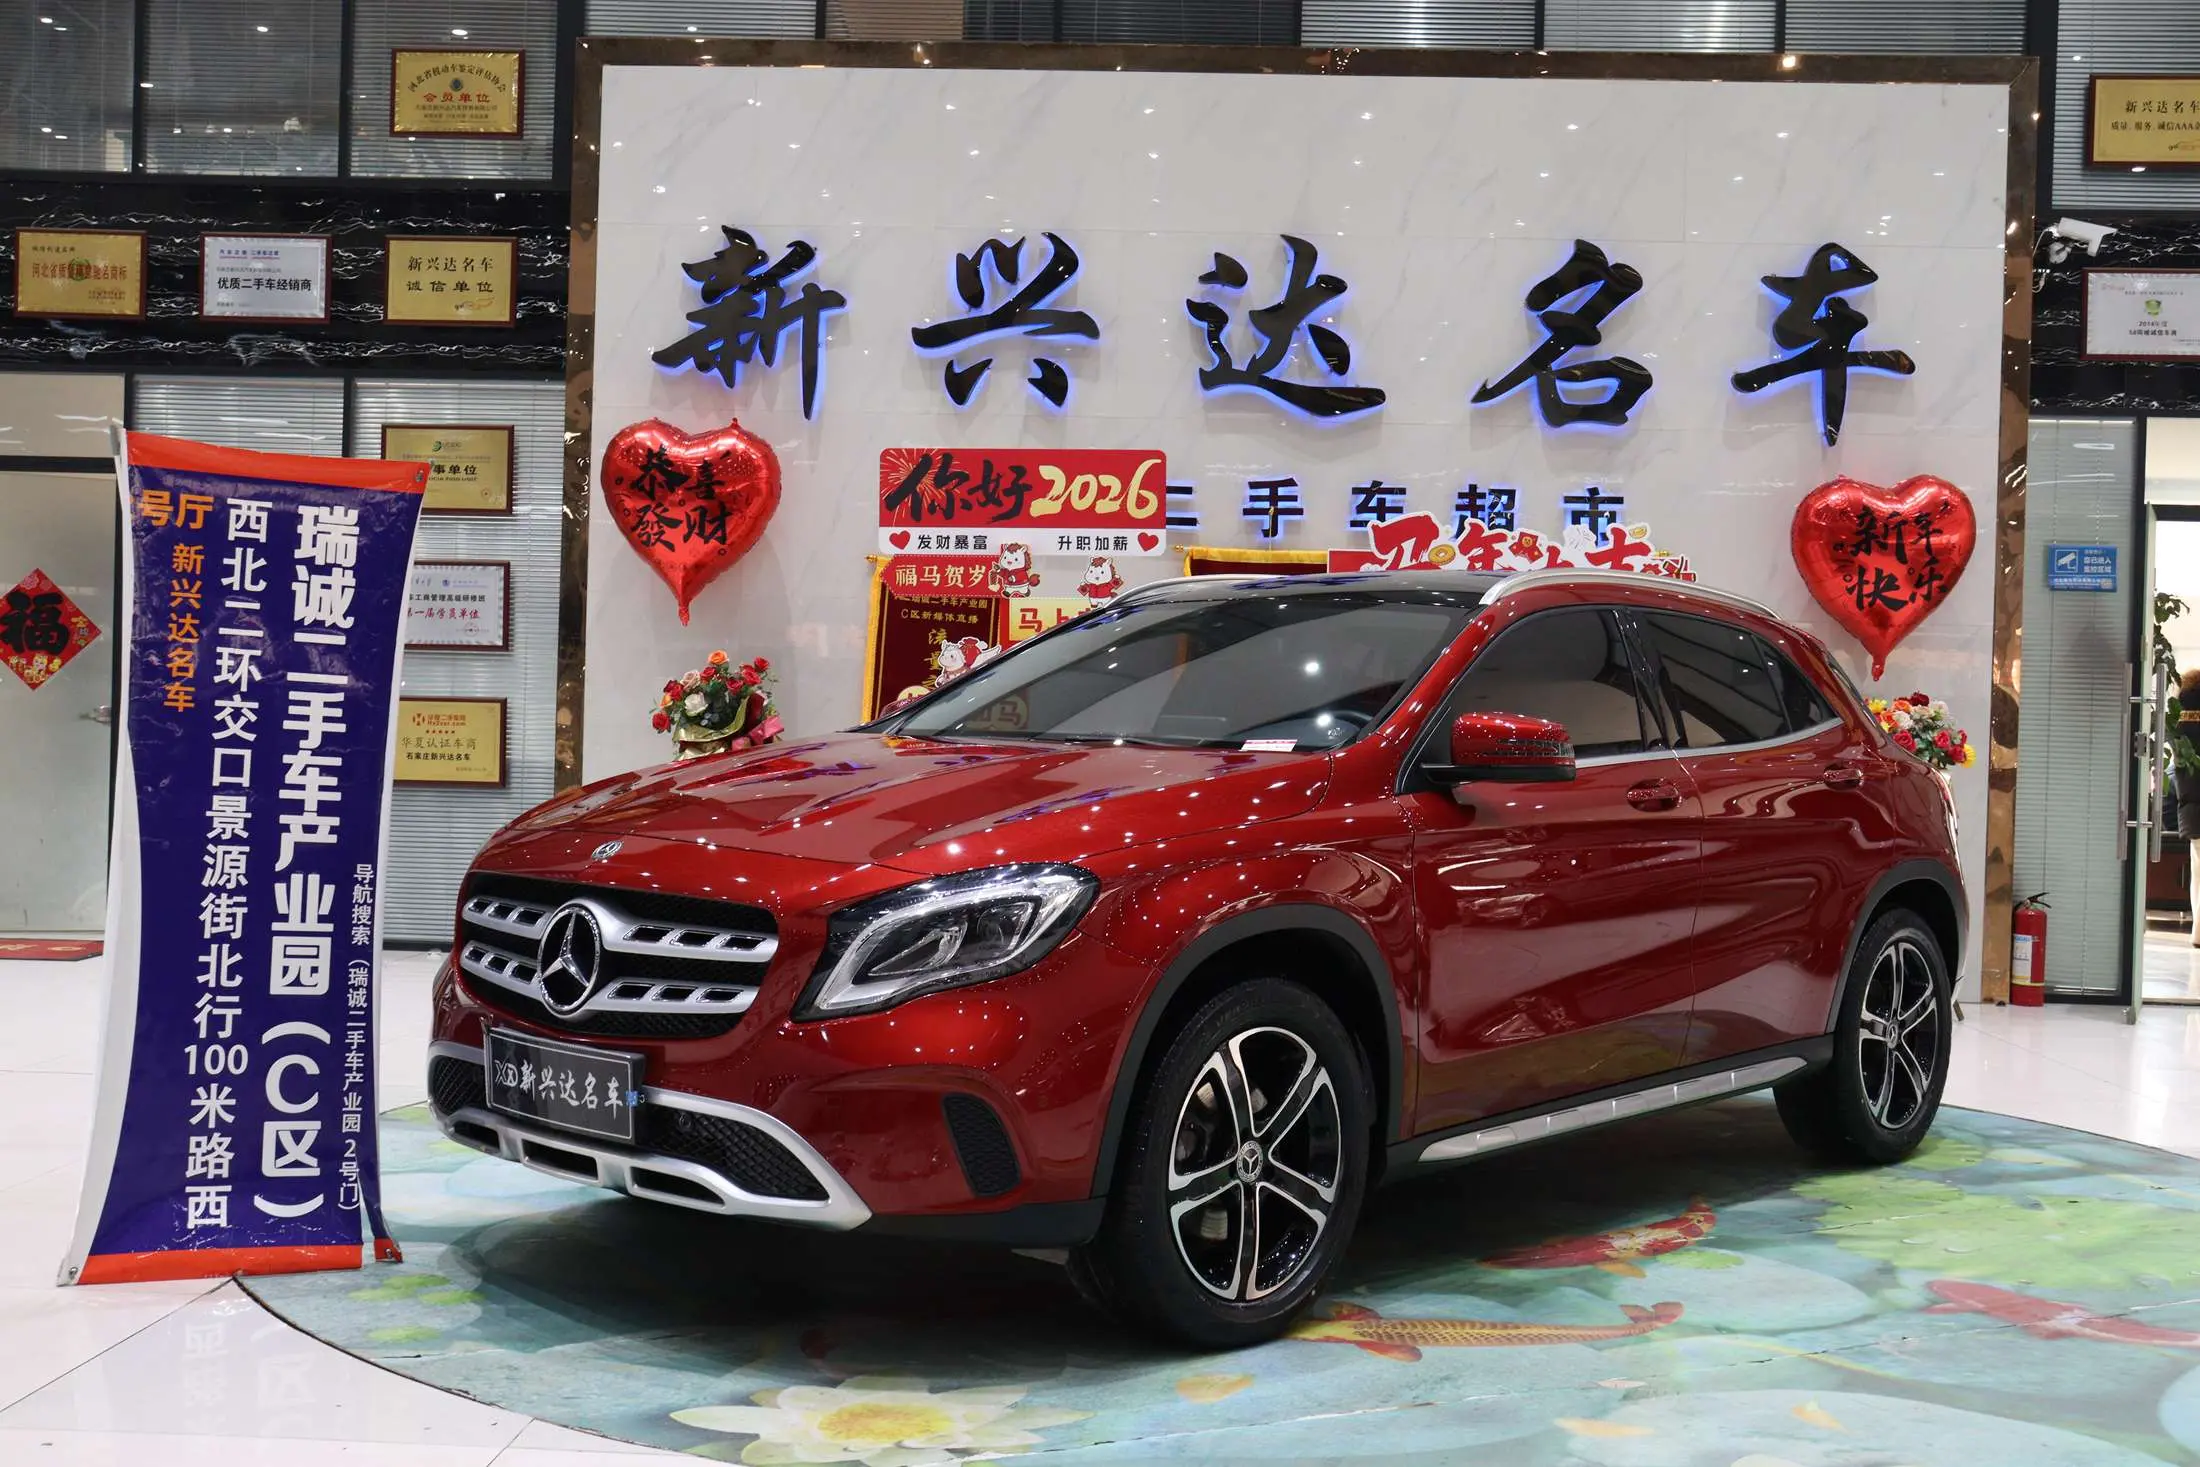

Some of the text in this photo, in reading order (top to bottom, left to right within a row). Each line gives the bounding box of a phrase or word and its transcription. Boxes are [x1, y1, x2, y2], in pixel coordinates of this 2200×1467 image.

[423, 92, 490, 103] 会员单位
[2126, 100, 2200, 114] 新兴达名车
[407, 256, 494, 273] 新兴达名车
[217, 277, 313, 292] 优质二手车经销商
[406, 280, 494, 293] 诚信单位
[652, 225, 1916, 447] 新兴达名车
[431, 463, 478, 476] 事单位
[1851, 502, 1945, 565] 新年
[917, 534, 988, 551] 发财暴富
[1057, 535, 1129, 552] 升职加薪
[895, 564, 986, 588] 福马贺岁
[1845, 555, 1949, 612] 快乐
[0, 592, 69, 655] 福
[901, 608, 979, 624] C区新媒体直播
[163, 543, 205, 712] 新兴达名车
[400, 736, 478, 750] 华夏认证车商
[405, 752, 472, 761] 石家庄新兴达名车
[184, 497, 273, 1229] 西北二环交口景源街北行100米路西
[519, 1058, 624, 1121] 新兴达名车
